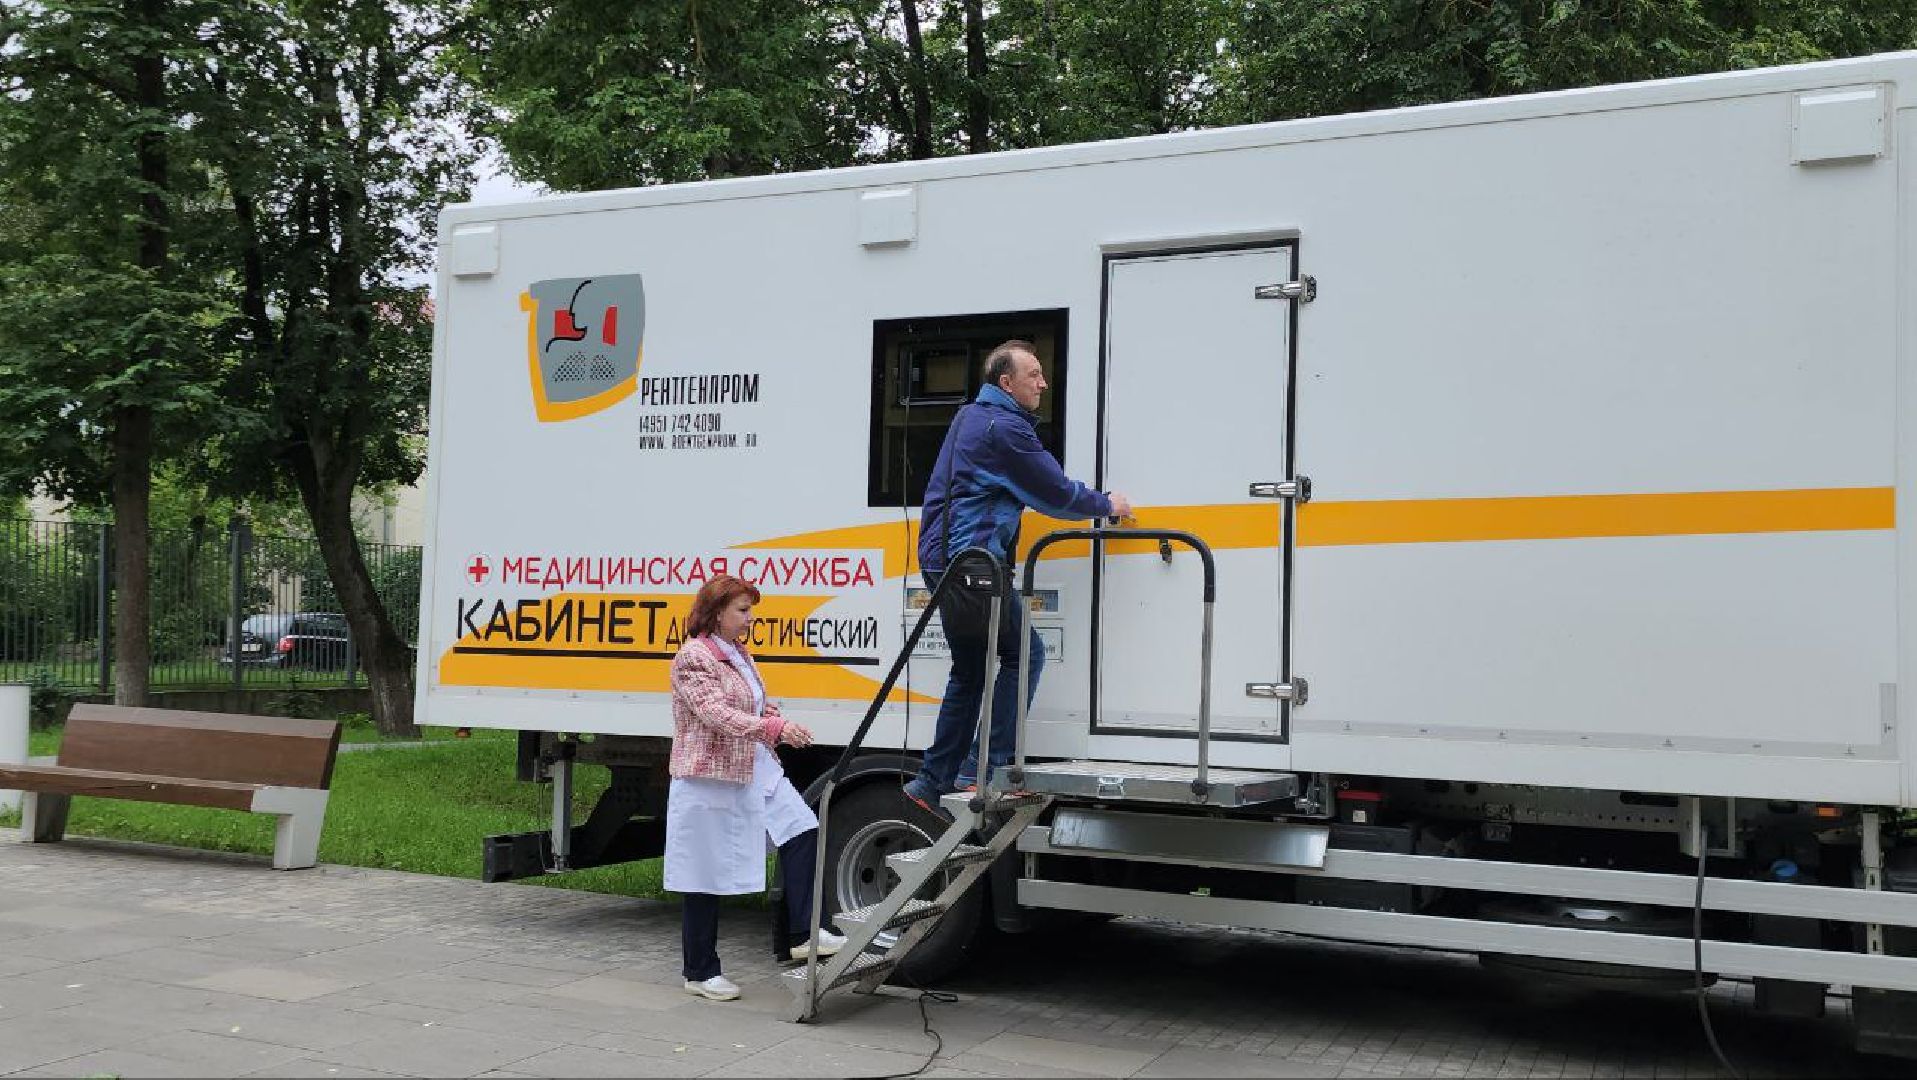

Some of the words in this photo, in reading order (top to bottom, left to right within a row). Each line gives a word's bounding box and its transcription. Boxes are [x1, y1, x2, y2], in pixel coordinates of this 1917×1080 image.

[641, 373, 760, 406] РЕНТГЕНПРОМ
[671, 413, 691, 433] 742
[693, 412, 721, 433] 4090
[502, 556, 728, 591] МЕДИЦИНСКАЯ
[738, 556, 874, 587] СЛУЖБА
[457, 598, 668, 645] КАБИНЕТ
